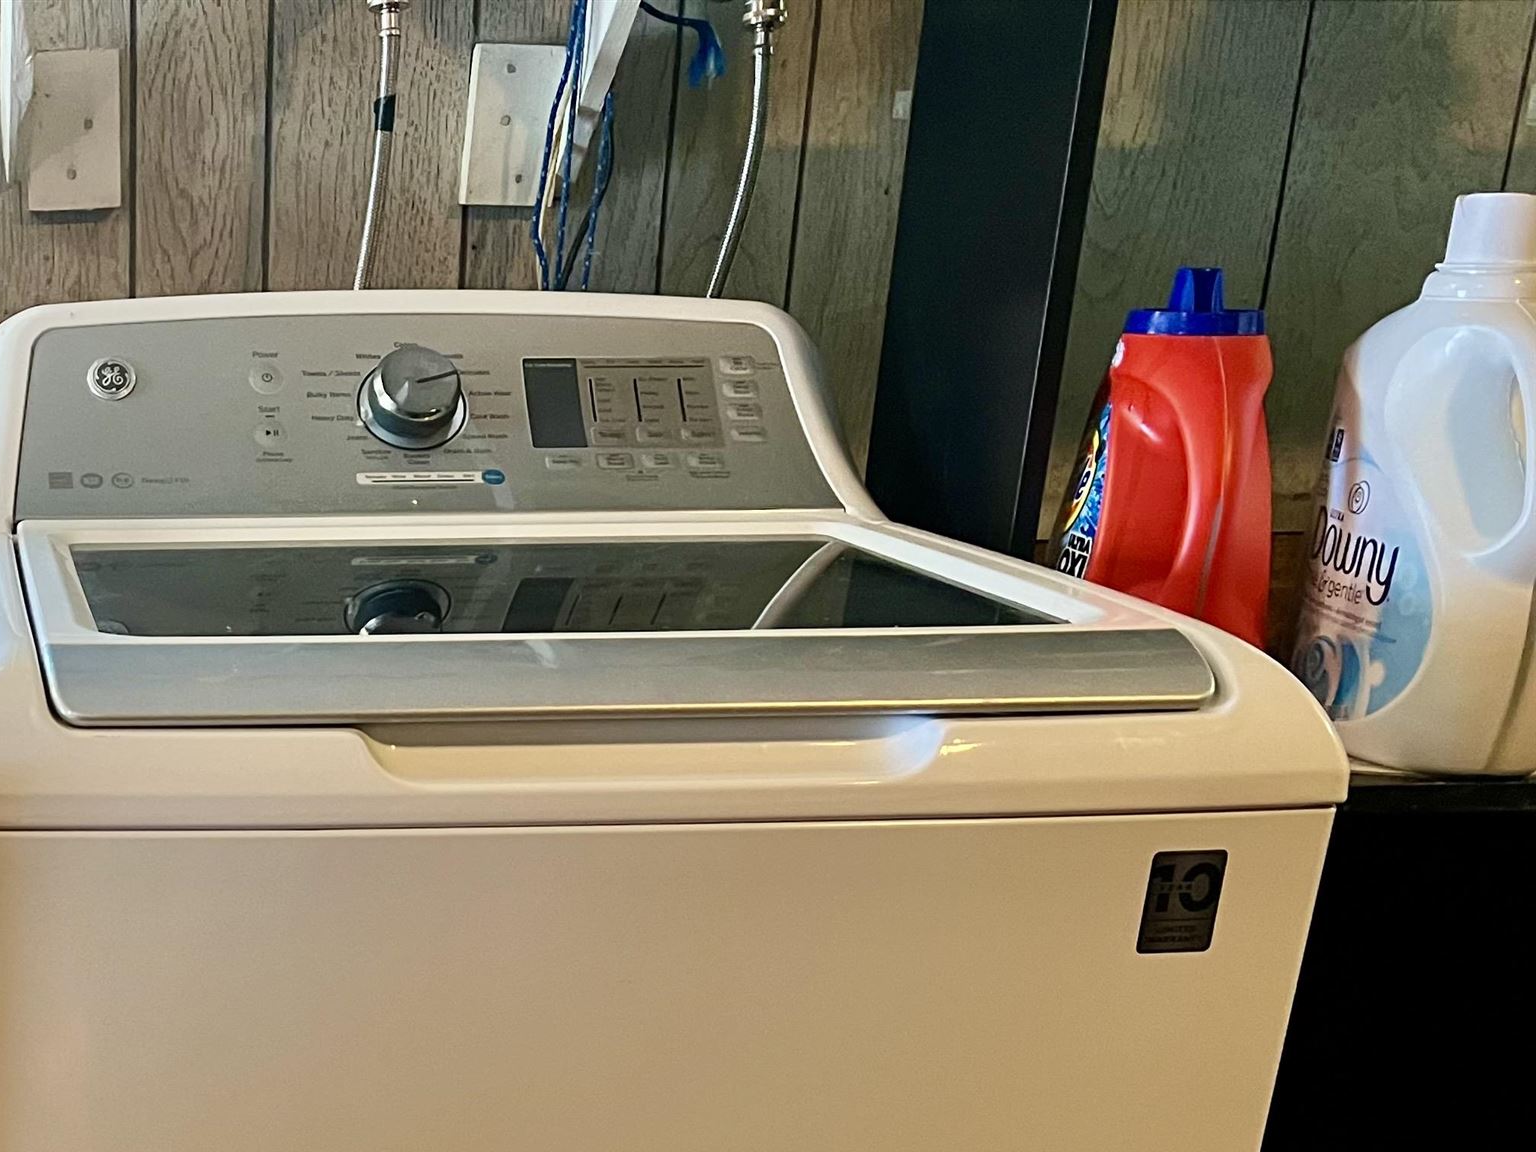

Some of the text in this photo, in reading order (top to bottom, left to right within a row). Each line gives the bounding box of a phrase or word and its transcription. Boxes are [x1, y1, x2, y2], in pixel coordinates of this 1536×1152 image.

[1057, 548, 1088, 578] OXI
[1312, 505, 1399, 605] Downy
[1327, 581, 1362, 604] gentle
